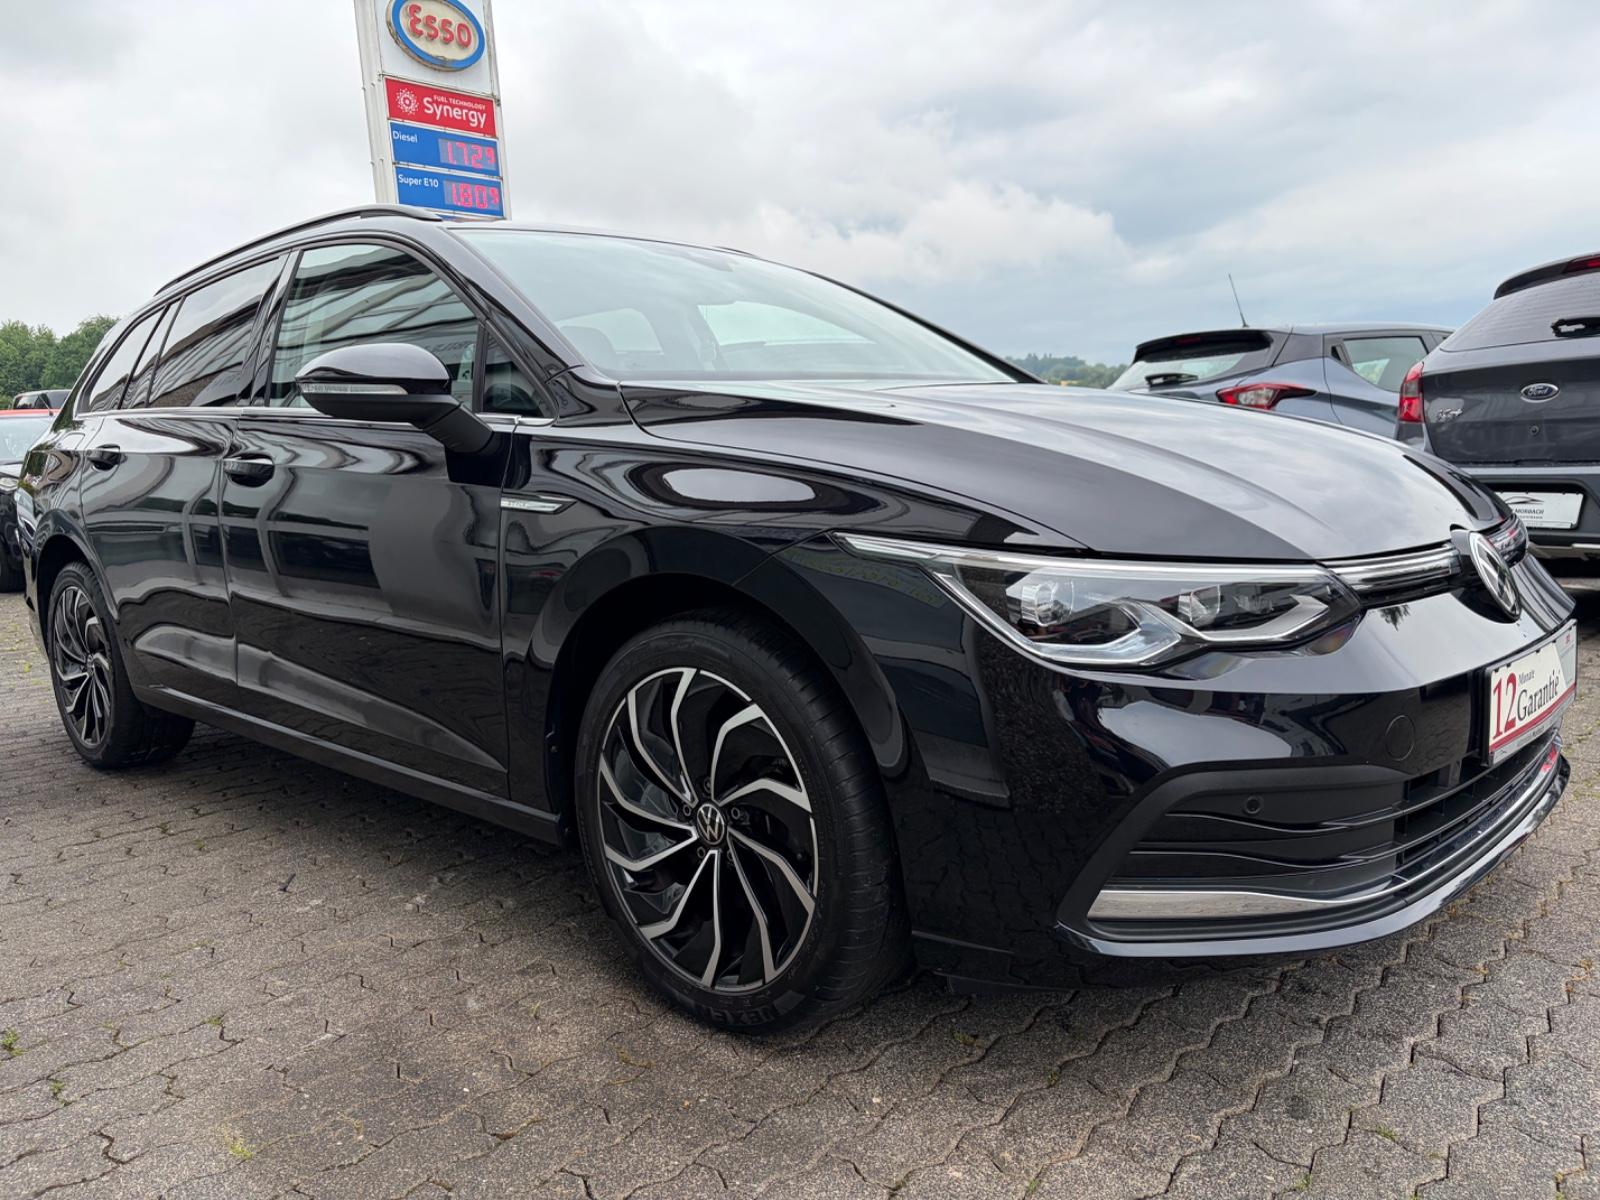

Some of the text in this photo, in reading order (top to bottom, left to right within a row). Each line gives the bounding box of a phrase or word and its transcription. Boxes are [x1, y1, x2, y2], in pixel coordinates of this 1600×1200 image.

[433, 94, 486, 110] FUEL TECHNOLOGY
[423, 97, 487, 129] Synergy
[392, 130, 418, 143] Diesel
[398, 174, 439, 188] Super E10
[1526, 385, 1550, 397] Ford
[1492, 672, 1517, 740] 12
